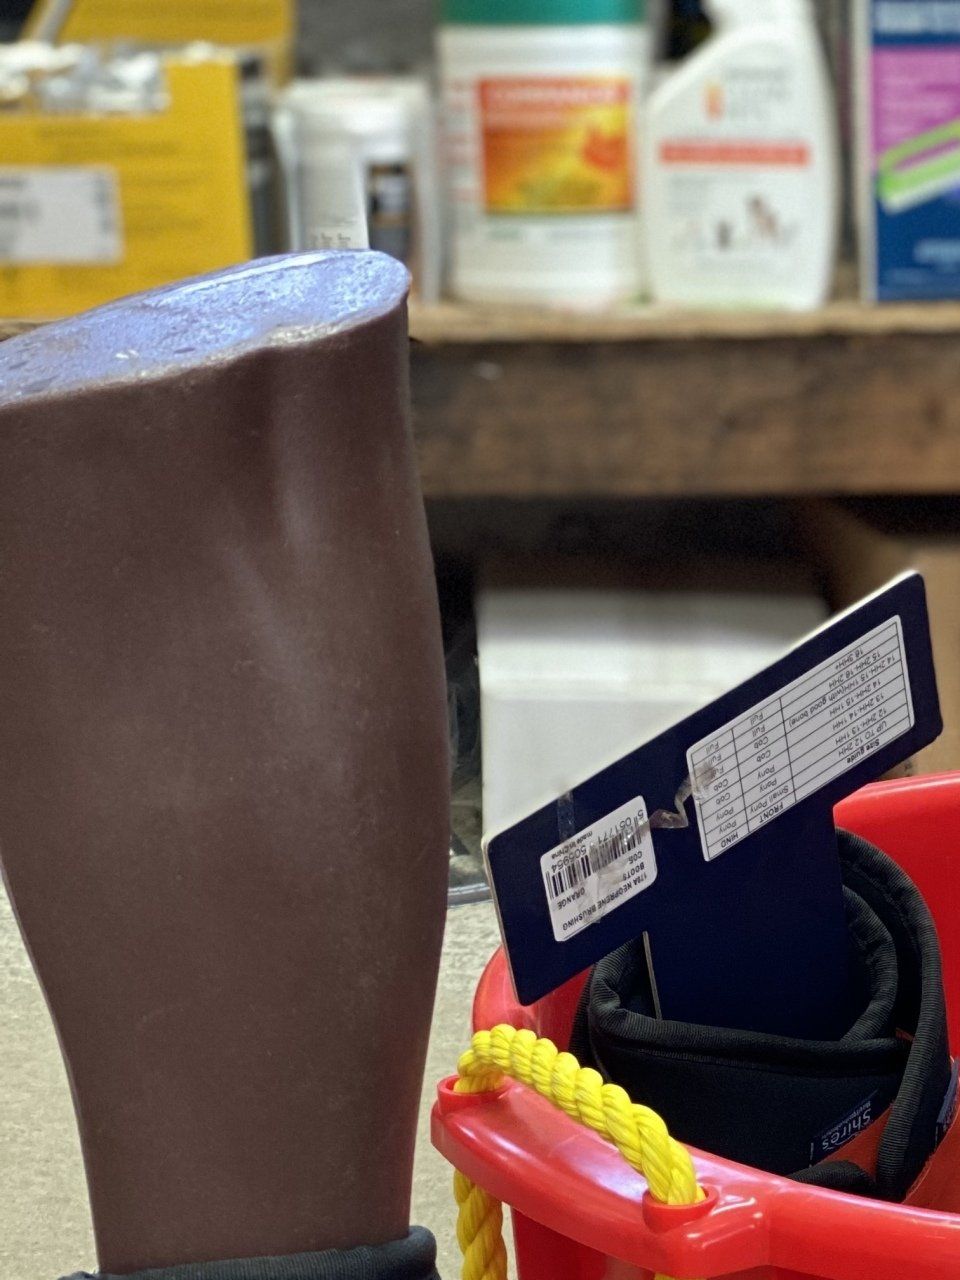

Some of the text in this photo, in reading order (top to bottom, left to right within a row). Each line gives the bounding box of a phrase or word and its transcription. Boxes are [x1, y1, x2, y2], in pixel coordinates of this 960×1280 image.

[809, 696, 826, 714] good
[750, 711, 763, 725] Full
[788, 708, 808, 729] bone)
[875, 718, 886, 732] UP
[752, 723, 764, 737] Full
[864, 726, 874, 739] TO
[706, 740, 719, 755] Full
[753, 734, 768, 751] Cob
[846, 736, 879, 764] Size guide
[756, 748, 770, 764] Cob
[757, 762, 774, 782] Pony
[713, 776, 728, 793] Cob
[759, 776, 776, 795] Pony
[715, 790, 730, 806] Cob
[749, 784, 788, 816] Small Pony
[637, 808, 643, 820] 5
[715, 804, 733, 823] Pony
[758, 800, 783, 823] FRONT
[718, 816, 736, 836] Pony
[720, 830, 738, 848] HIND
[551, 844, 569, 861] China
[551, 843, 586, 874] 505954
[622, 861, 644, 882] BOOTS
[557, 885, 584, 910] ORANGE
[597, 880, 631, 910] NEOPRENE
[562, 903, 596, 932] BRUSHING
[822, 1107, 872, 1150] Shires
